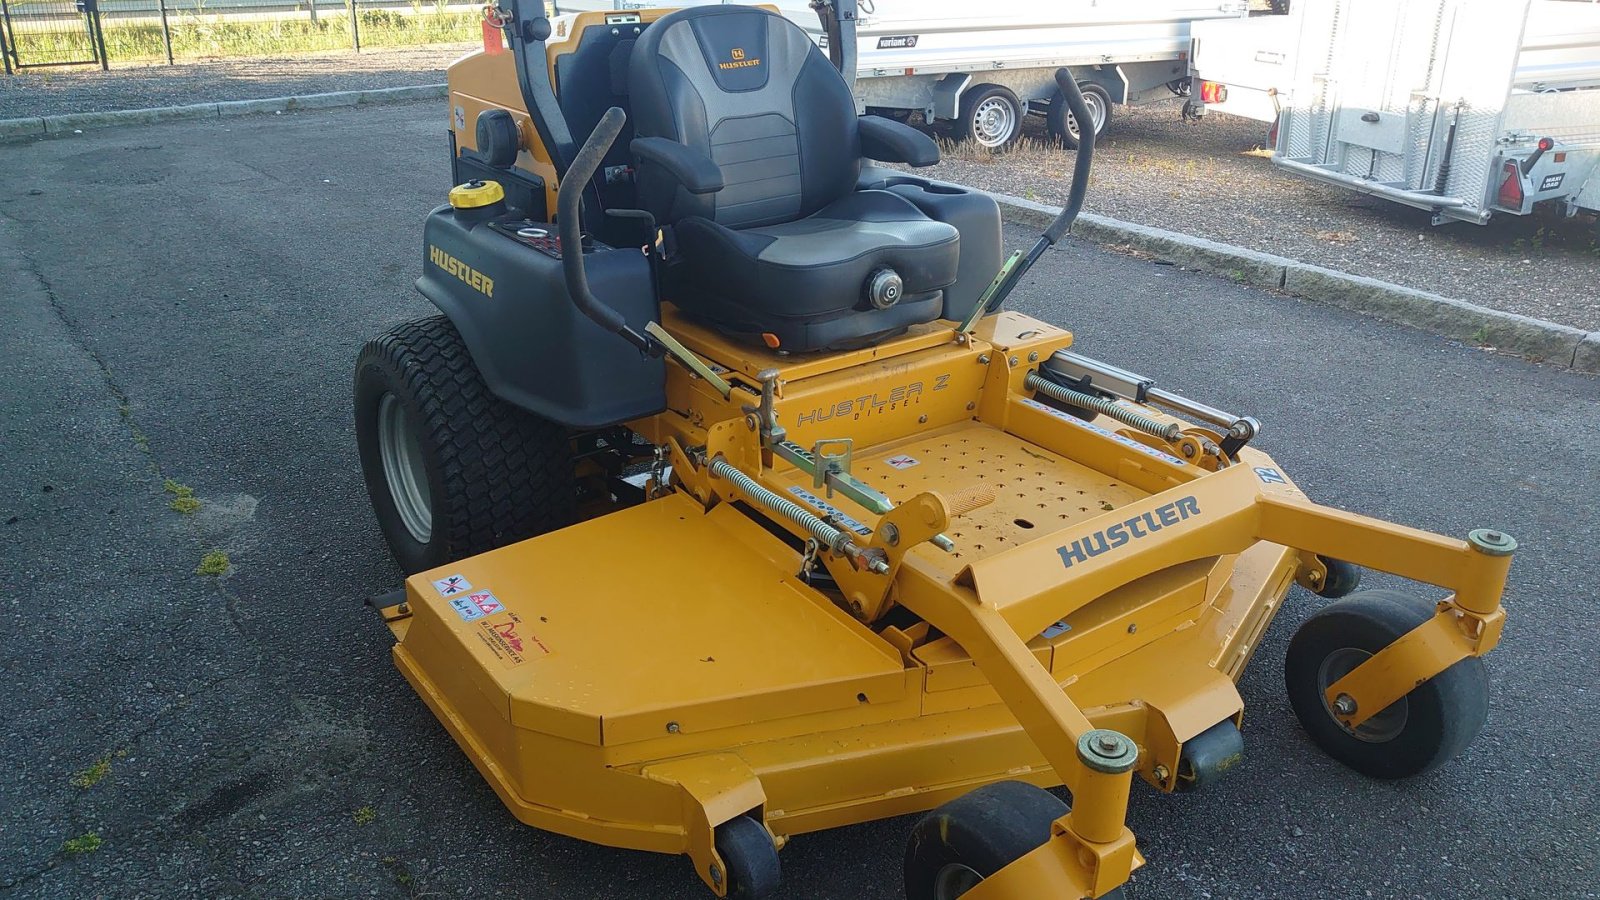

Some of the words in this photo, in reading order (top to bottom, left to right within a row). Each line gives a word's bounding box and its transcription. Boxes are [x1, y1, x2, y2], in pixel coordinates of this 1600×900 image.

[880, 37, 906, 48] variant
[719, 59, 760, 69] HUSTLER
[429, 244, 494, 298] HUSTLER
[797, 381, 924, 427] HUSTLER
[933, 374, 951, 391] Z
[853, 396, 920, 421] DIESEL
[1056, 495, 1201, 569] HUSTLER
